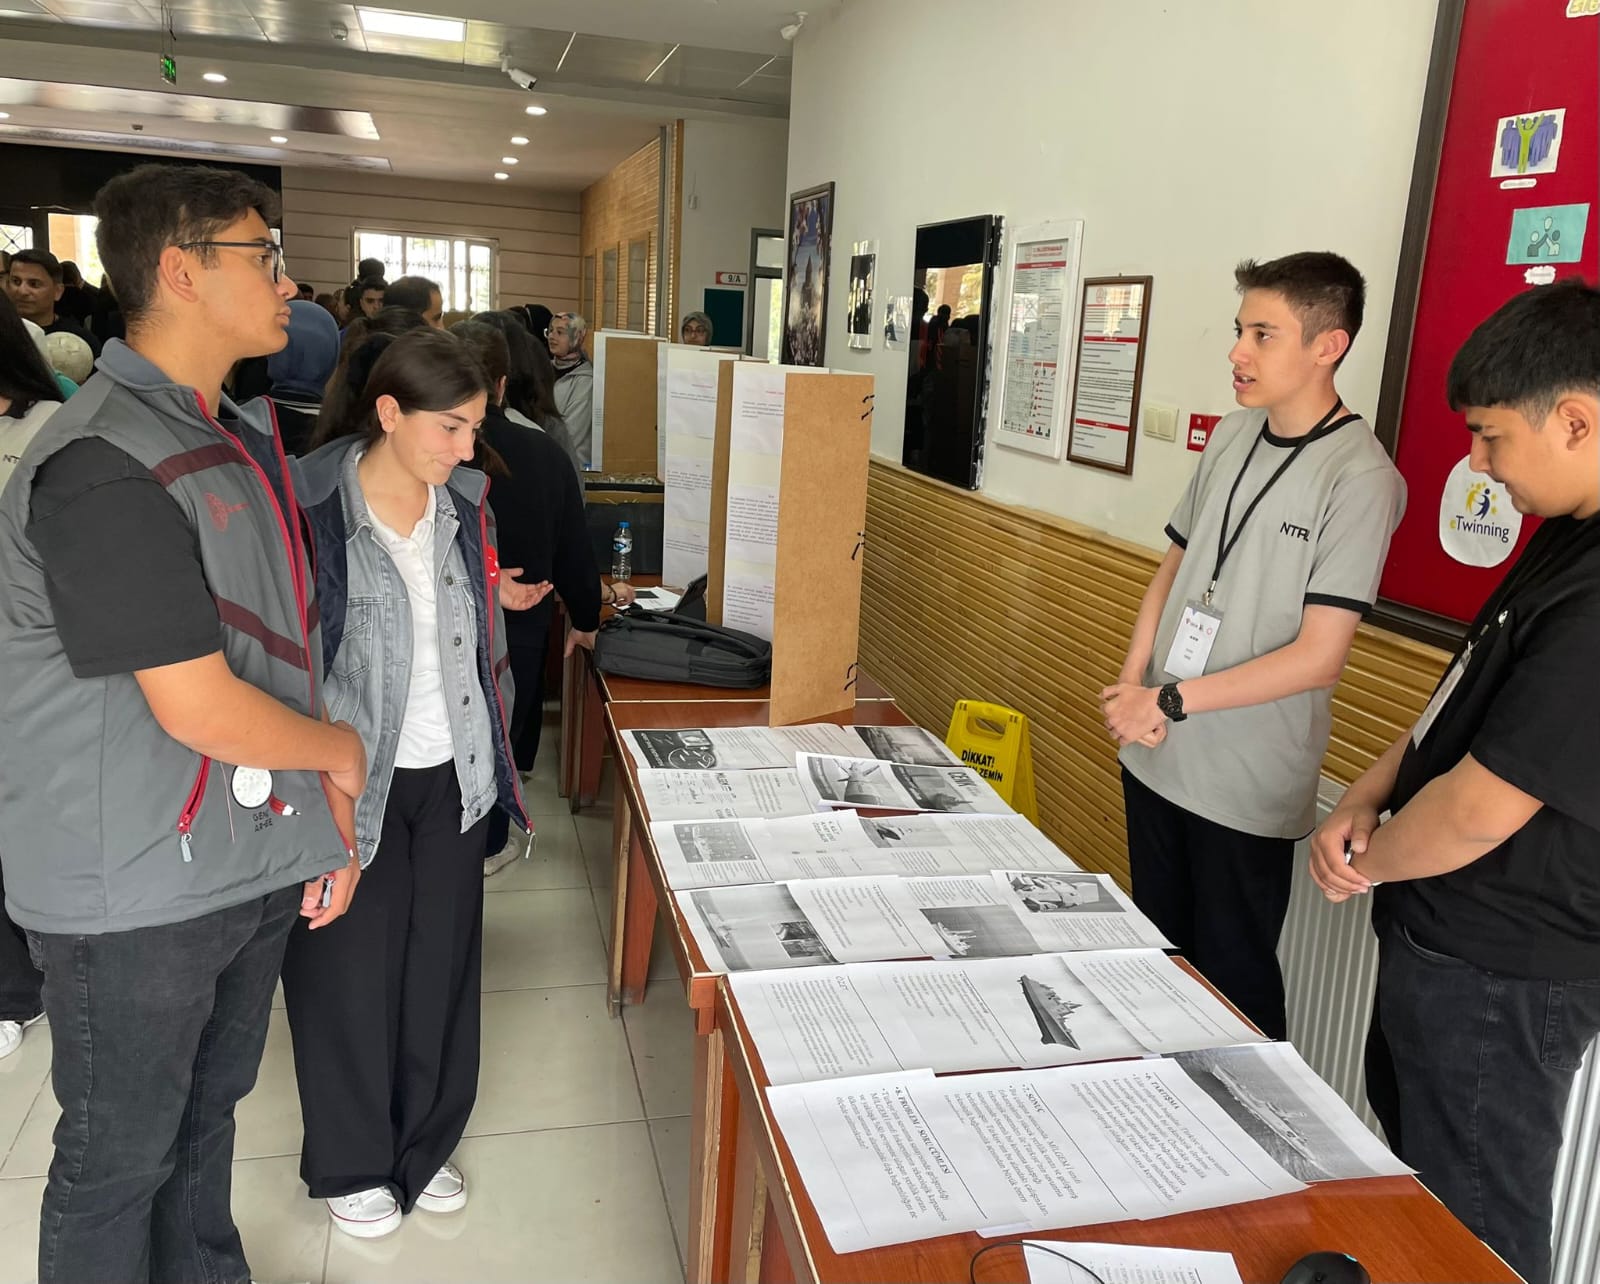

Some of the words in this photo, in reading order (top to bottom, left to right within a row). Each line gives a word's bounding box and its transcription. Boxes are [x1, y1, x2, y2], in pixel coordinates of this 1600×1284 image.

[728, 274, 741, 283] 9/A
[1450, 515, 1510, 543] eTwinning
[961, 749, 995, 767] DİKKAT!
[979, 767, 1004, 782] ZEMİN
[1024, 1093, 1046, 1113] SONUÇ
[1149, 1081, 1181, 1109] TARTIŞMA
[898, 1096, 921, 1124] PROBLEM
[918, 1129, 934, 1145] SORU
[928, 1146, 952, 1174] CÜMLESİ
